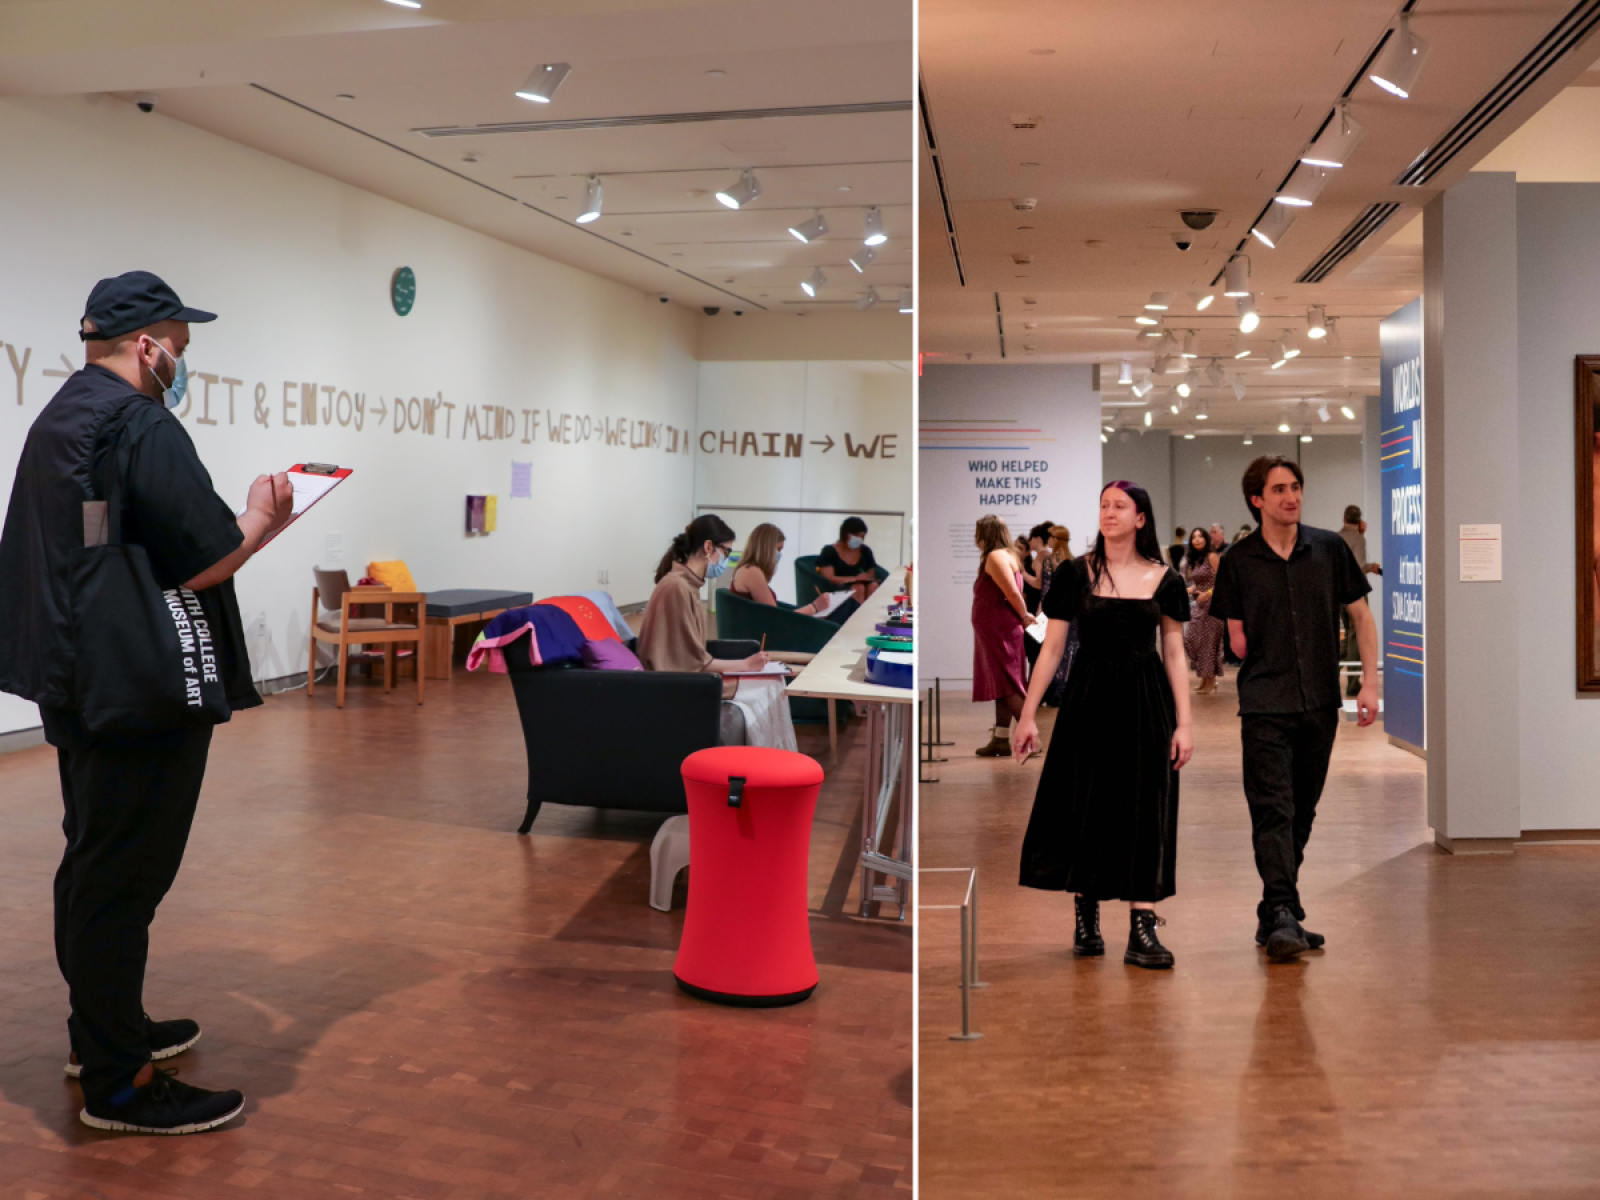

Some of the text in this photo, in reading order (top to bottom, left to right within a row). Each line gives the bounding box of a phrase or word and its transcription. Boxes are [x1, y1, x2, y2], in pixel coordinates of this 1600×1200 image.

[0, 340, 32, 405] Y
[254, 382, 269, 428] &
[283, 380, 365, 432] ENJOY
[394, 391, 456, 439] DON'T
[462, 403, 515, 441] MIND
[521, 408, 540, 444] IF
[699, 430, 803, 458] CHAIN
[844, 432, 897, 459] WE
[1392, 356, 1420, 413] WORLDS
[968, 460, 1049, 472] WHO HELPED
[1412, 419, 1421, 470] IN
[975, 477, 1041, 489] MAKE THIS
[979, 494, 1037, 505] HAPPEN?
[1391, 483, 1421, 535] PROCESS
[162, 589, 203, 707] MUSEUM of ART
[193, 620, 218, 683] COLLEGE
